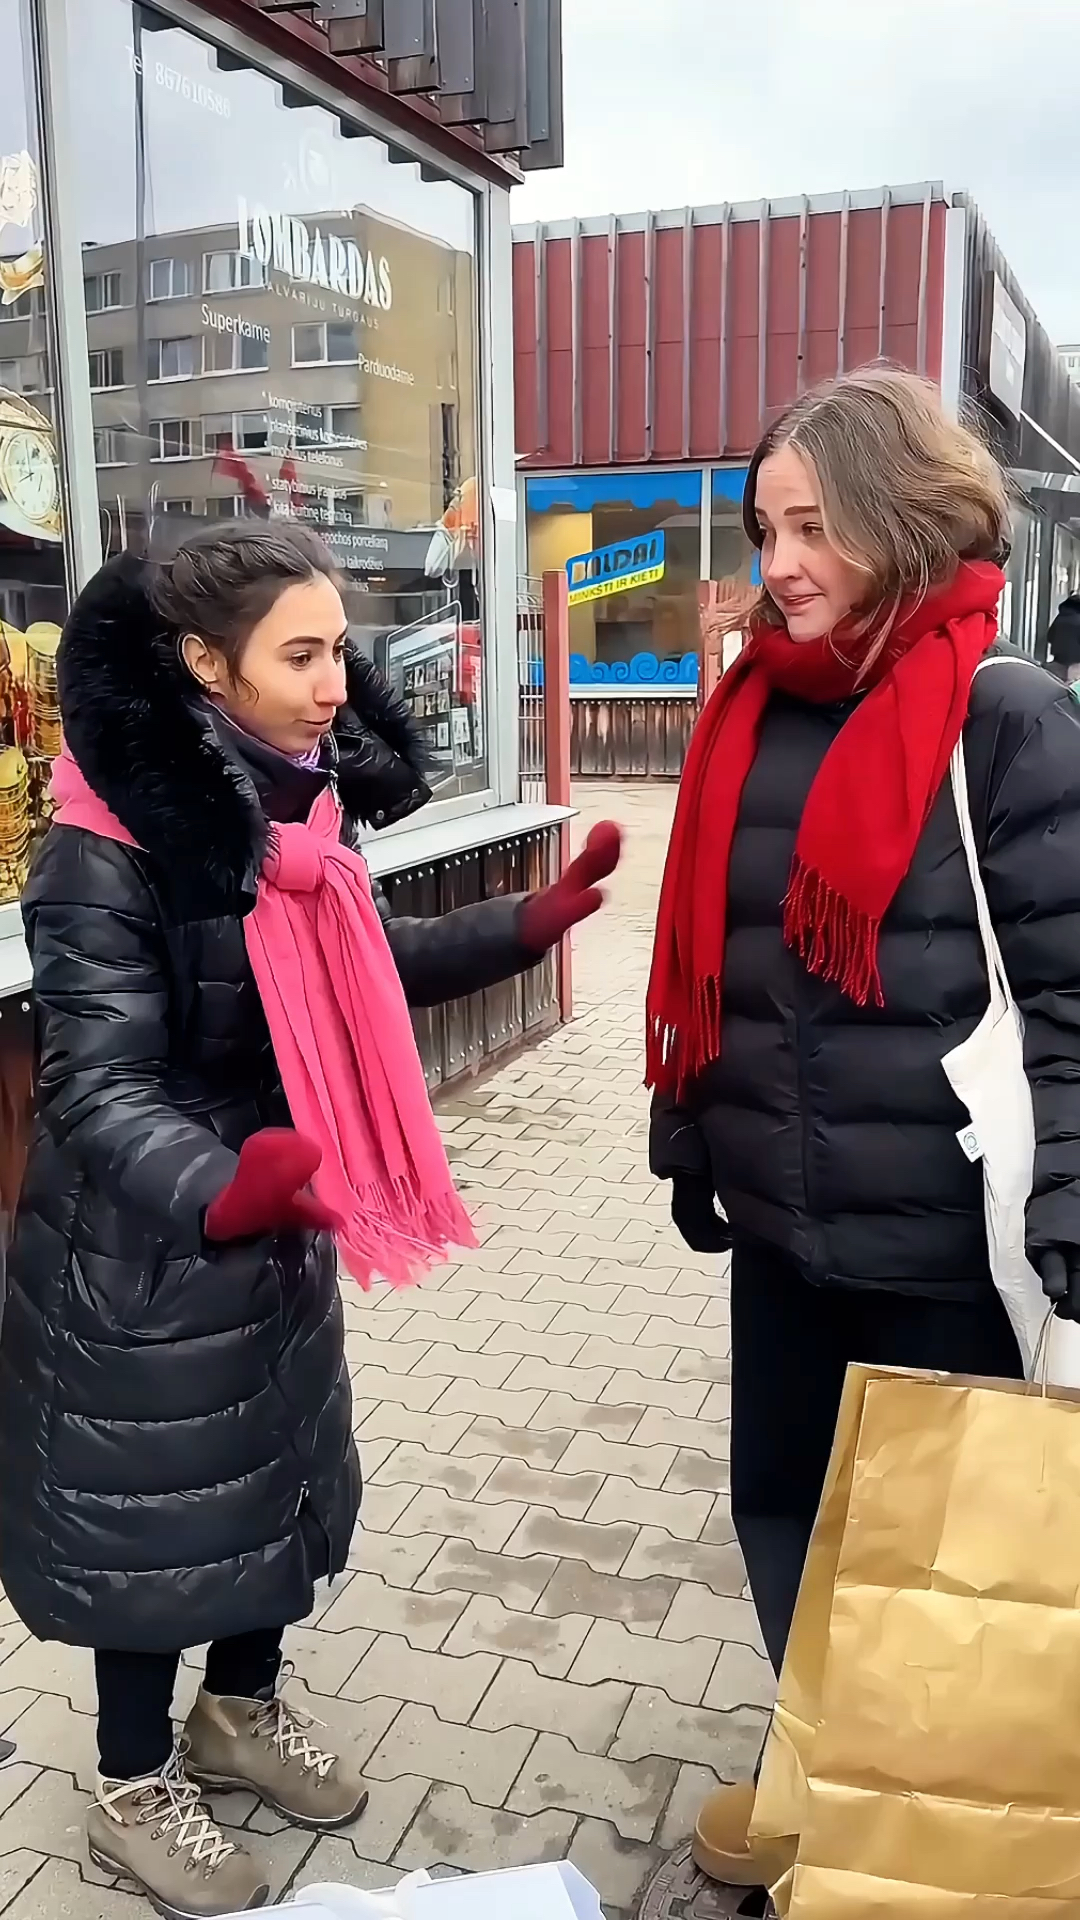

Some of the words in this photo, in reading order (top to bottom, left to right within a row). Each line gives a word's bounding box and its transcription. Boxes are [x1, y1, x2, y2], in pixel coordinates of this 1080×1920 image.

[238, 194, 393, 311] LOMBARDAS
[201, 303, 271, 343] Superkame
[332, 303, 380, 331] TURGAUS
[358, 352, 415, 386] Parduodame
[616, 578, 627, 589] IR
[630, 568, 658, 585] KIETI
